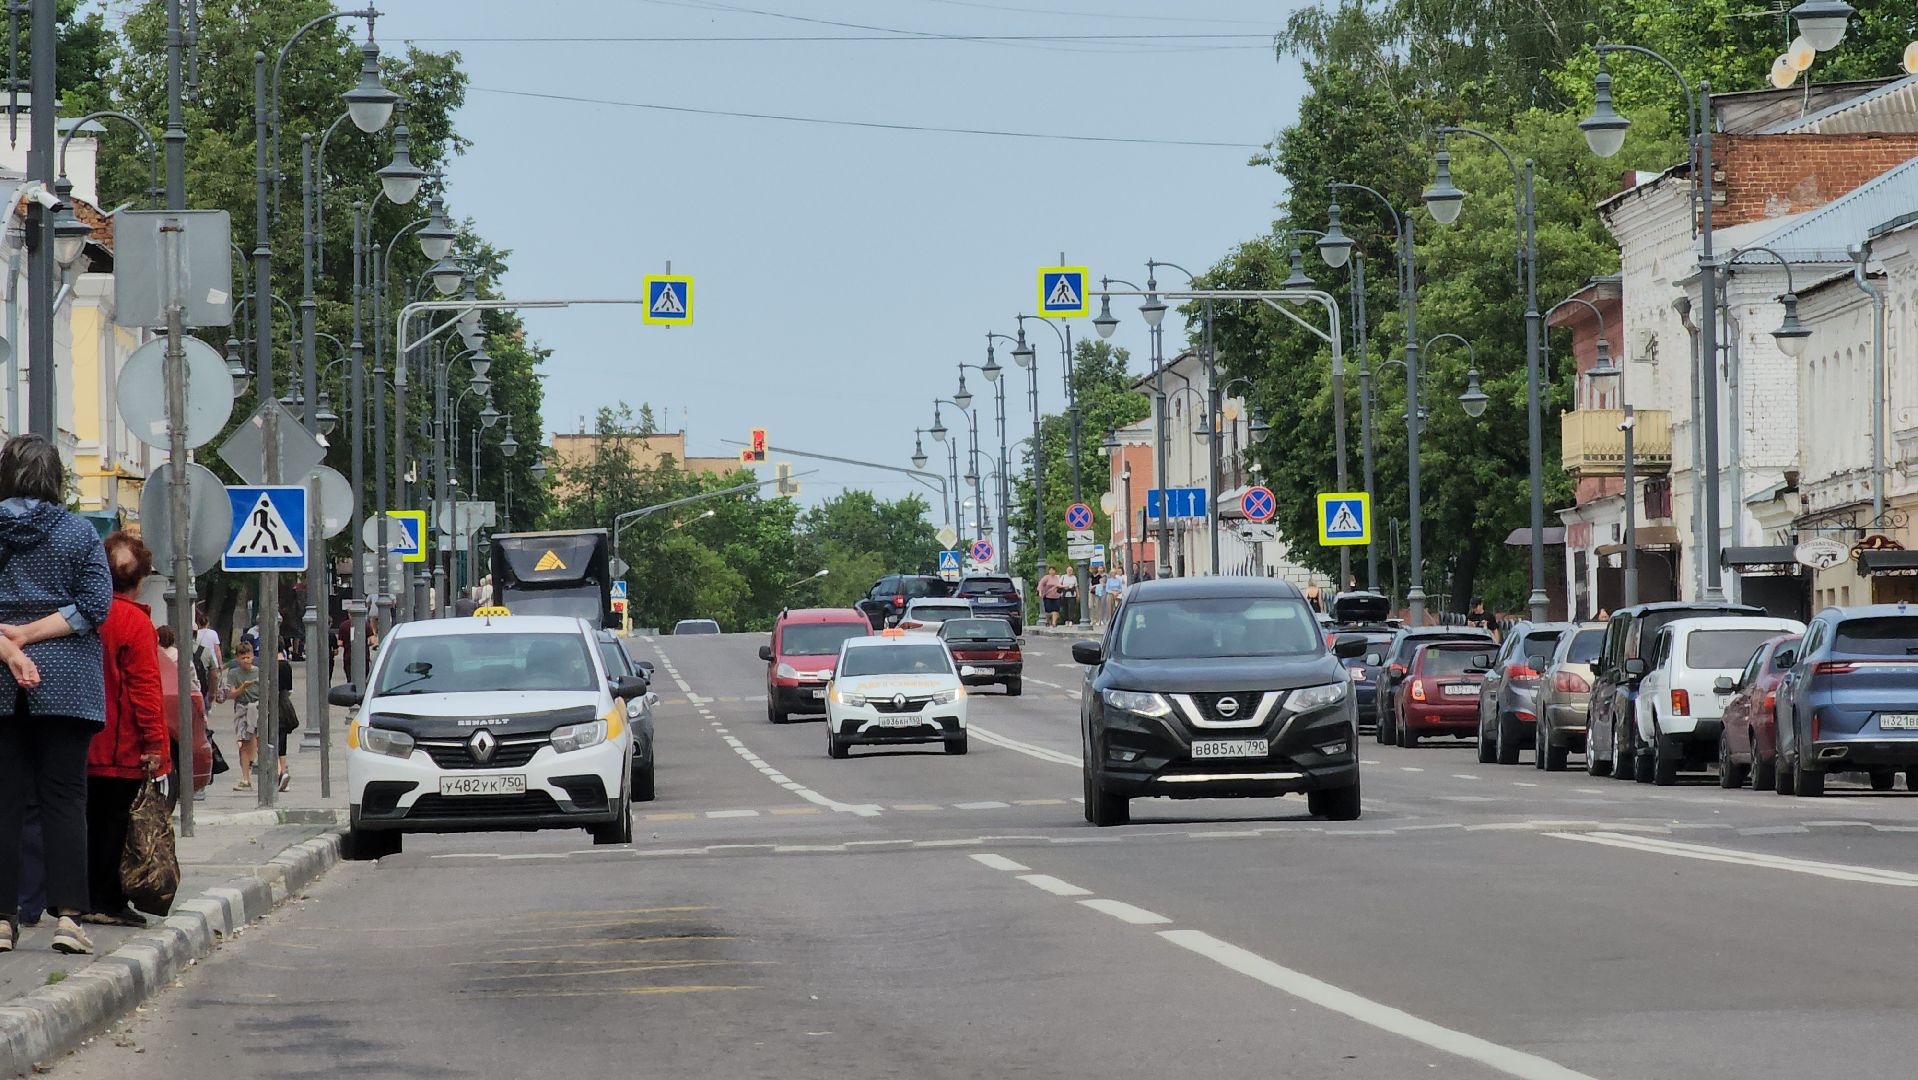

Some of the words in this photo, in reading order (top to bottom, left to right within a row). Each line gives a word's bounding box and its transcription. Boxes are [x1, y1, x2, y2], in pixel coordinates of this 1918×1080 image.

[457, 718, 510, 726] RENAULT
[1195, 743, 1244, 755] В885АХ
[1246, 741, 1265, 751] 790
[445, 779, 498, 793] У482УК
[500, 777, 521, 788] 750
